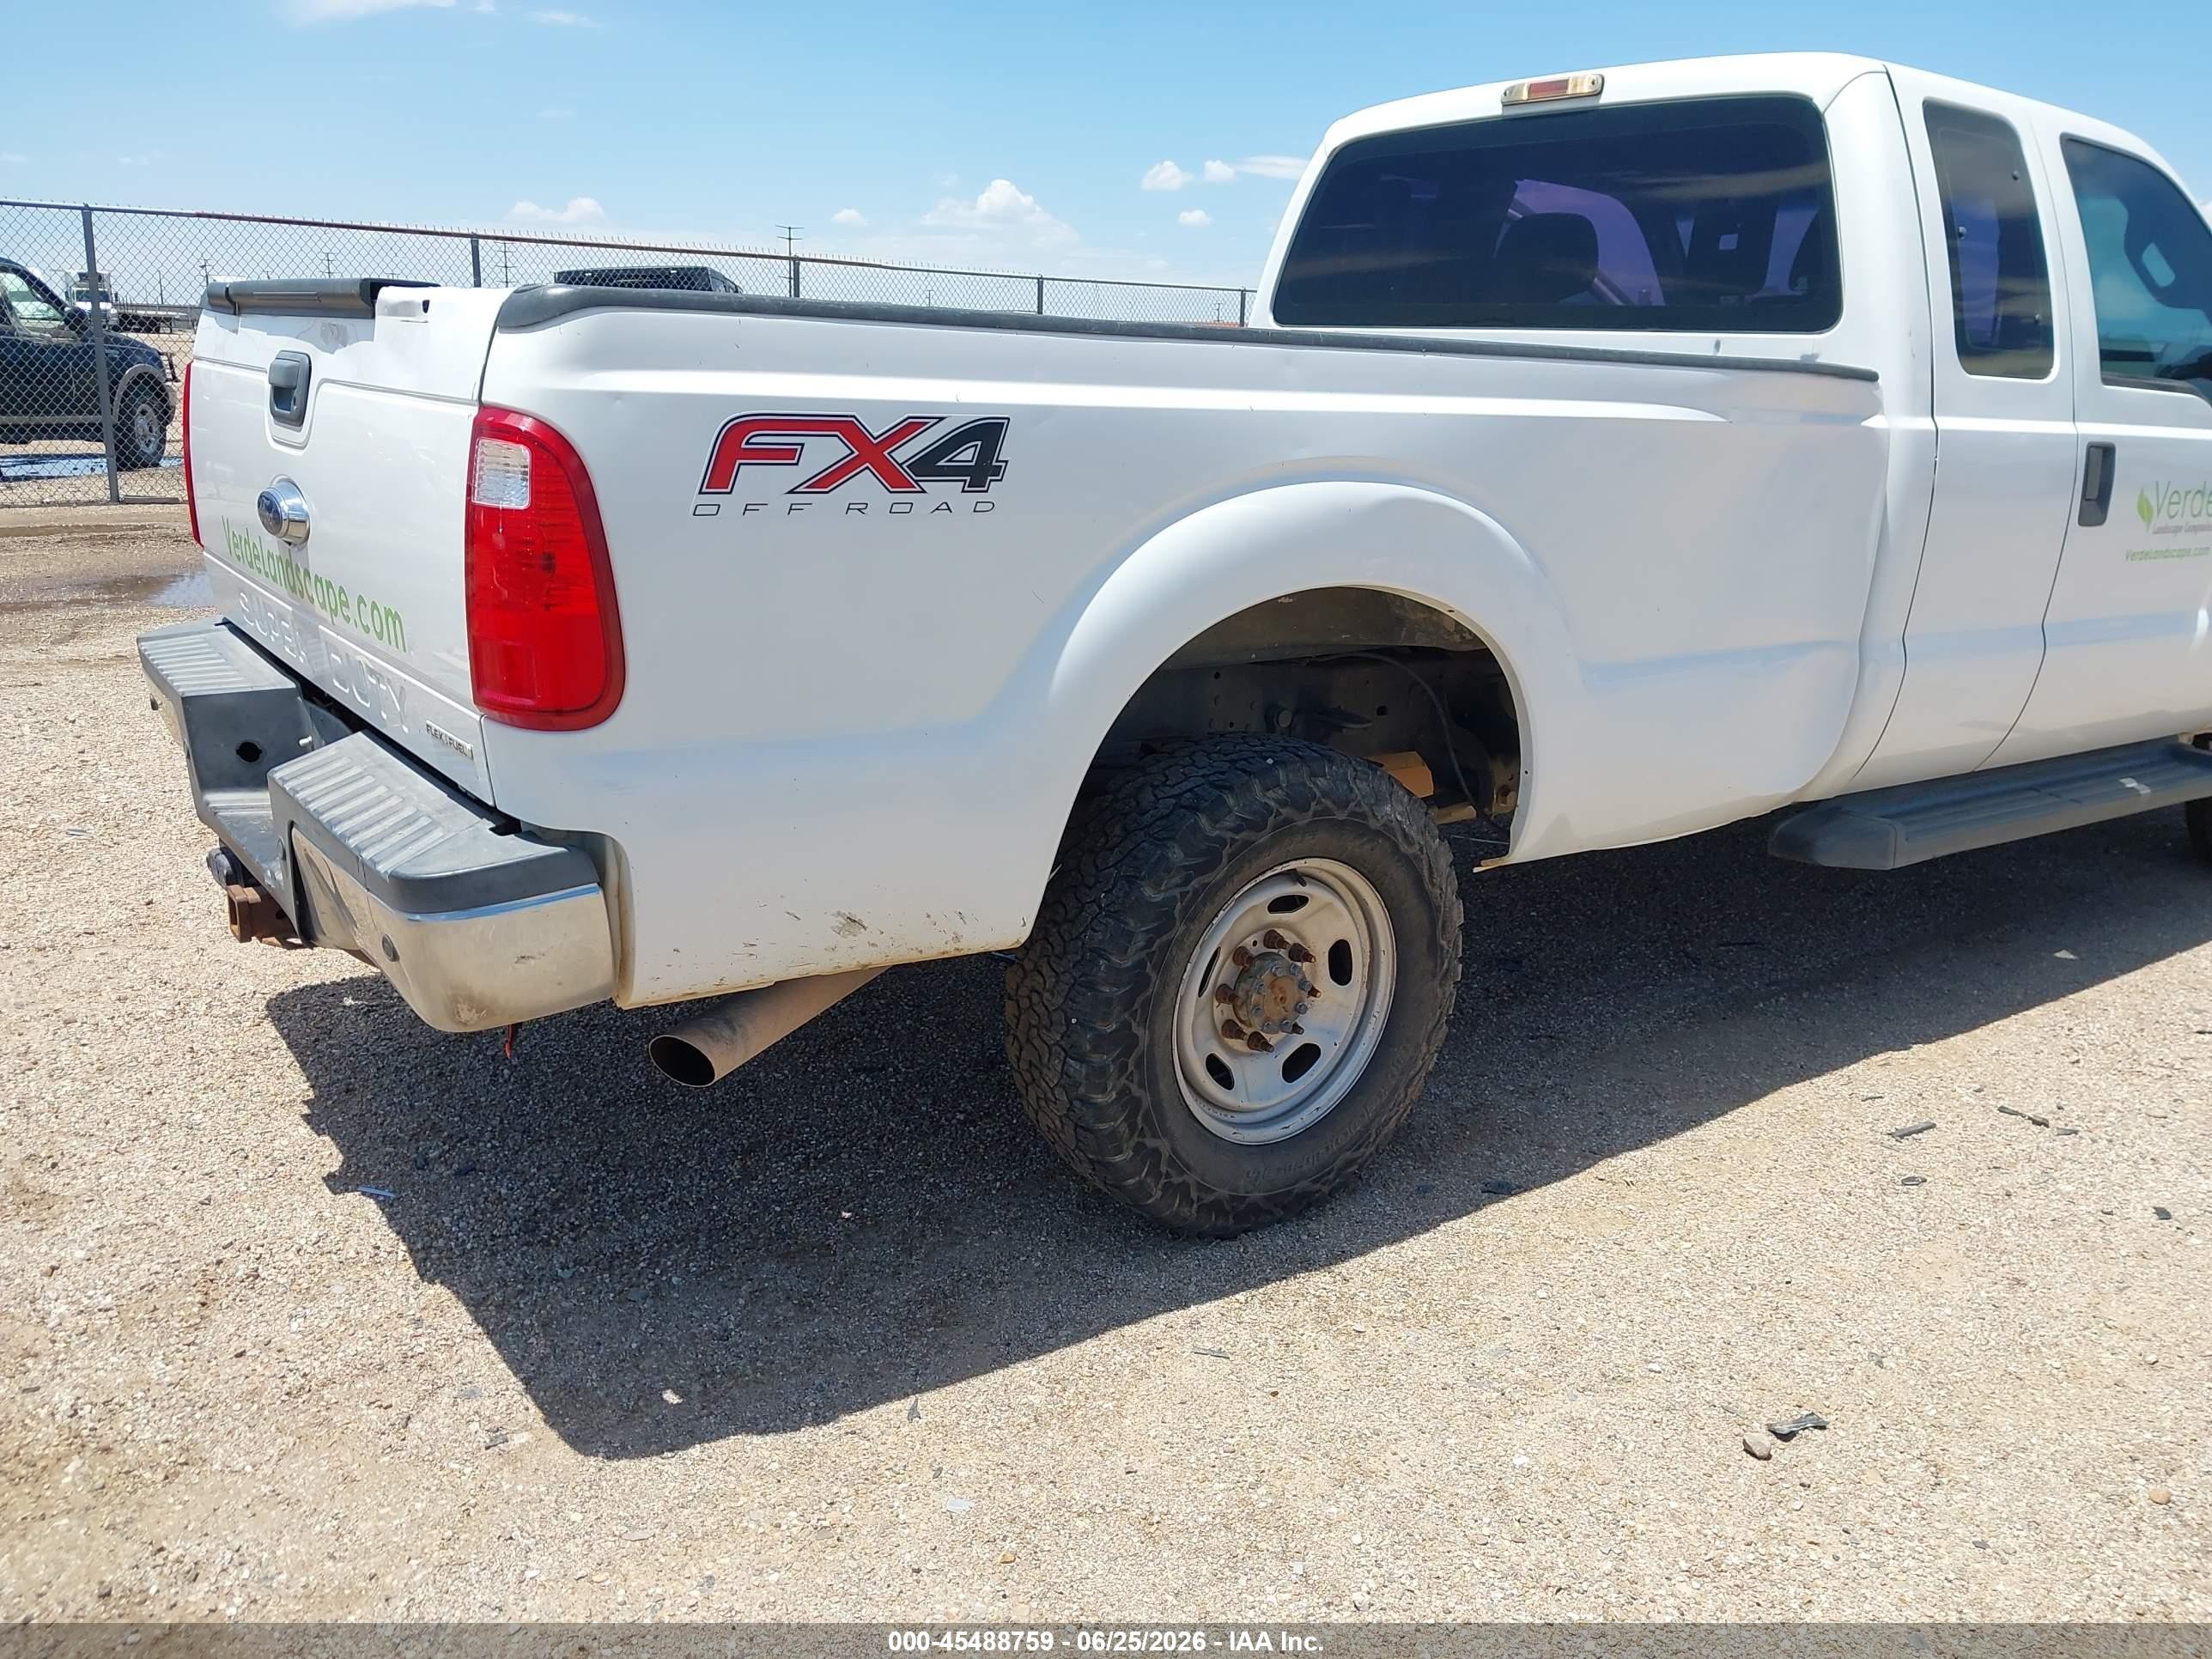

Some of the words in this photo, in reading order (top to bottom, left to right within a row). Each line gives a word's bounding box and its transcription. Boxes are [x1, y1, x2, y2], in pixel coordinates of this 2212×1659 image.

[698, 411, 1011, 495] FX4
[692, 502, 813, 517] OFF
[845, 501, 996, 515] ROAD
[222, 515, 407, 653] VerdeLandscape.com
[323, 639, 410, 735] DUTY
[426, 723, 445, 744] FLEX
[448, 738, 468, 757] FUEL
